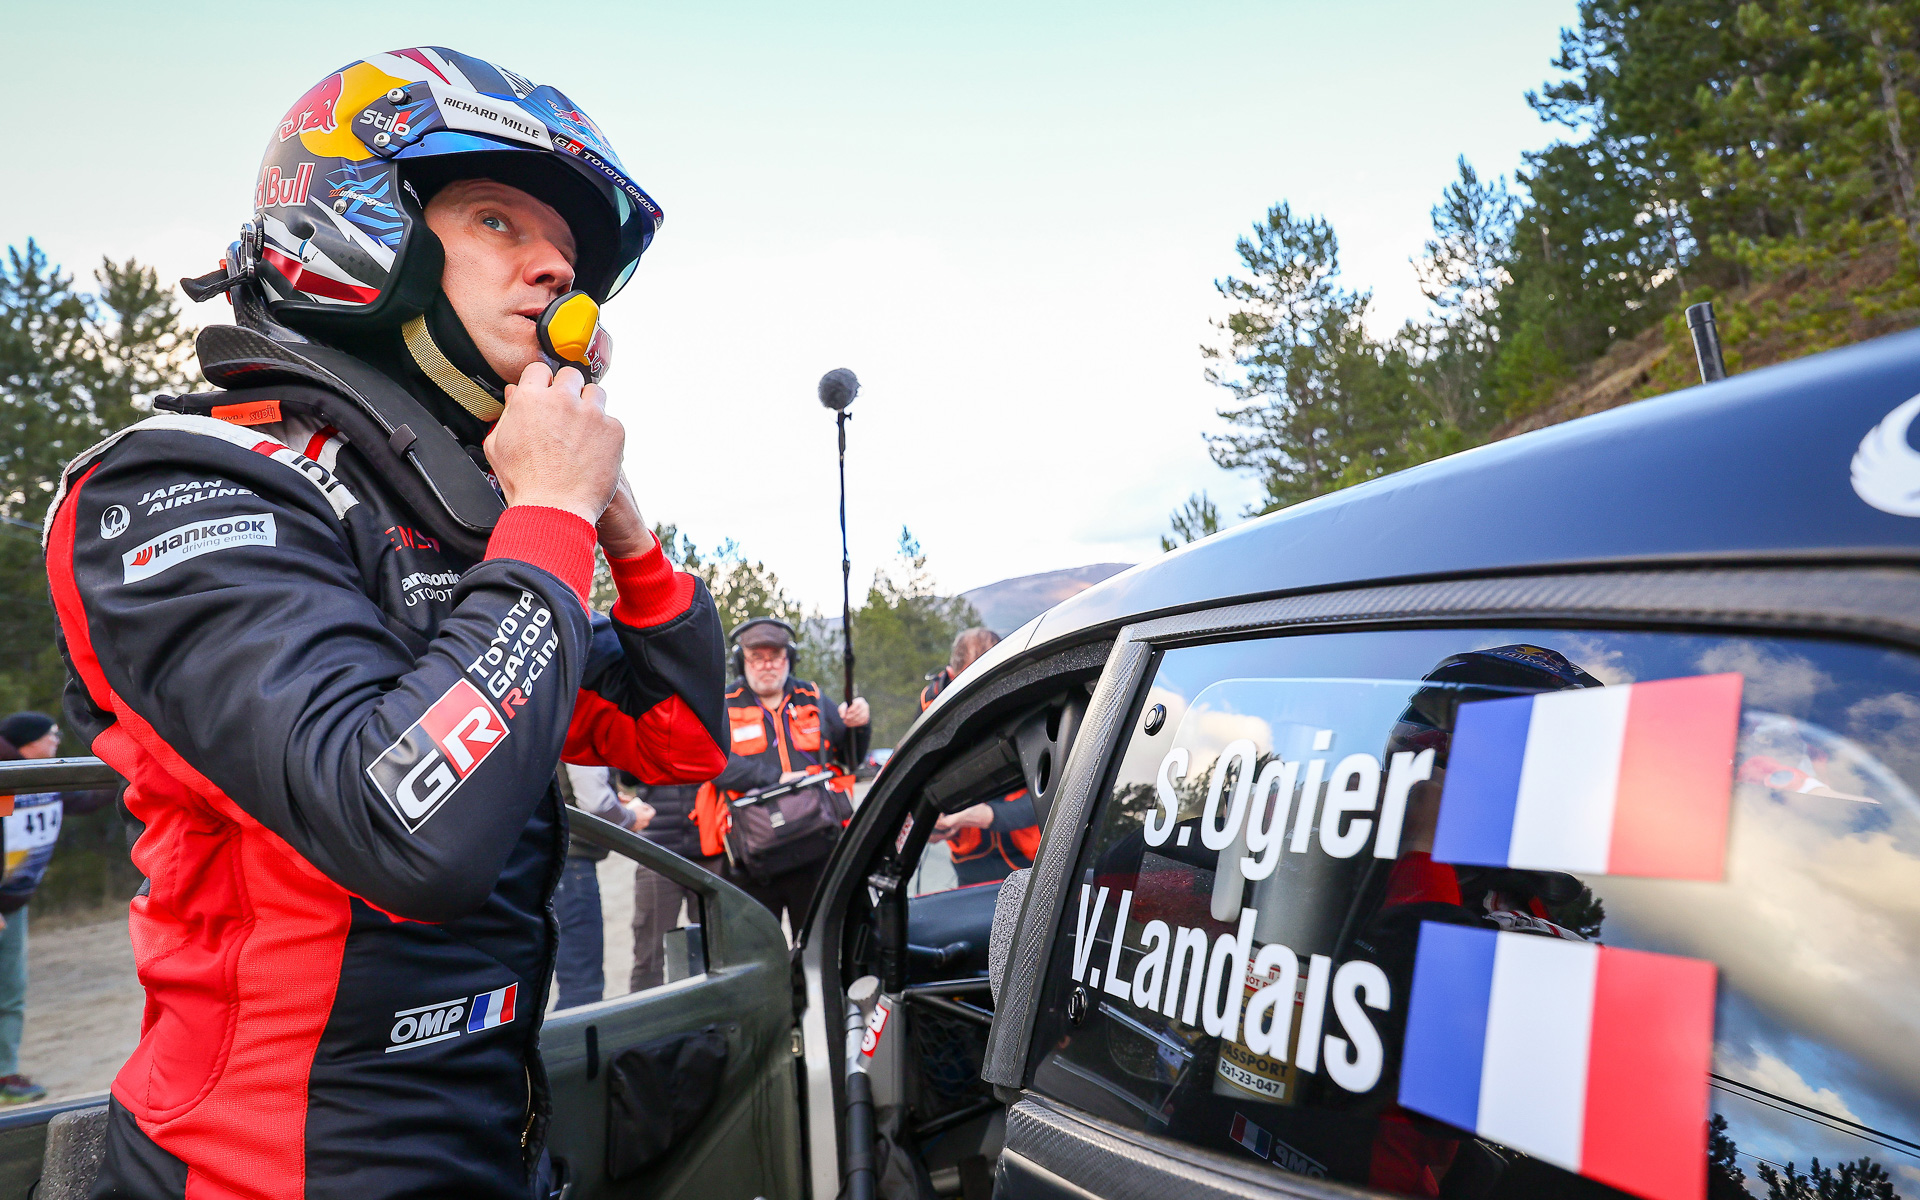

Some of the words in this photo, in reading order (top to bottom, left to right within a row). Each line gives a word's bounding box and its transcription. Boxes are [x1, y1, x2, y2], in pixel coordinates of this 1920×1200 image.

[359, 109, 411, 136] Stilo
[444, 97, 498, 121] RICHARD
[502, 116, 540, 139] MILLE
[266, 163, 315, 207] Bull
[554, 136, 581, 153] GR
[584, 151, 626, 186] TOYOTA
[625, 184, 655, 213] GAZOO
[137, 480, 222, 506] JAPAN
[109, 524, 127, 537] JAL
[182, 537, 220, 554] driving
[224, 533, 268, 543] emotion
[466, 590, 534, 678] TOYOTA
[487, 608, 551, 699] GAZOO
[500, 627, 559, 719] Racing
[396, 706, 502, 819] GR
[390, 1005, 465, 1044] OMP
[1220, 1060, 1281, 1094] Ra1-23-047
